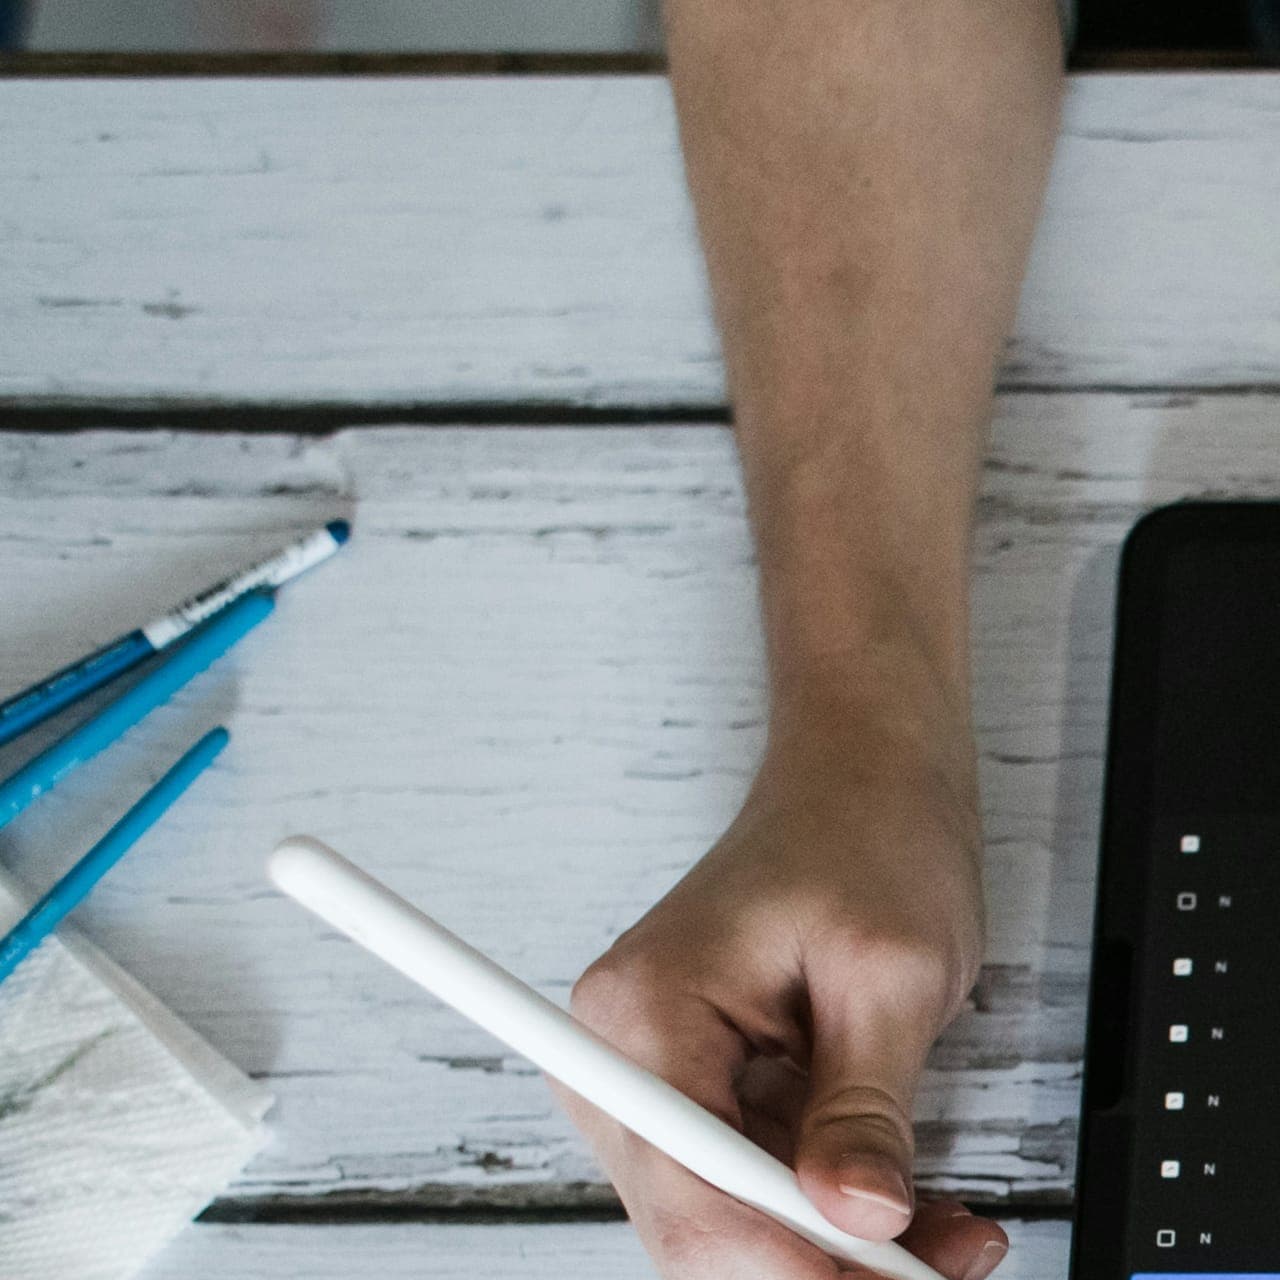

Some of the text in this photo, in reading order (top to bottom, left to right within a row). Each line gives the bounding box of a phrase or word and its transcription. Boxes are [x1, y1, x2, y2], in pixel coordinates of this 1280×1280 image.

[1207, 1095, 1220, 1107] N
[1203, 1163, 1216, 1176] N
[1199, 1232, 1212, 1245] N
